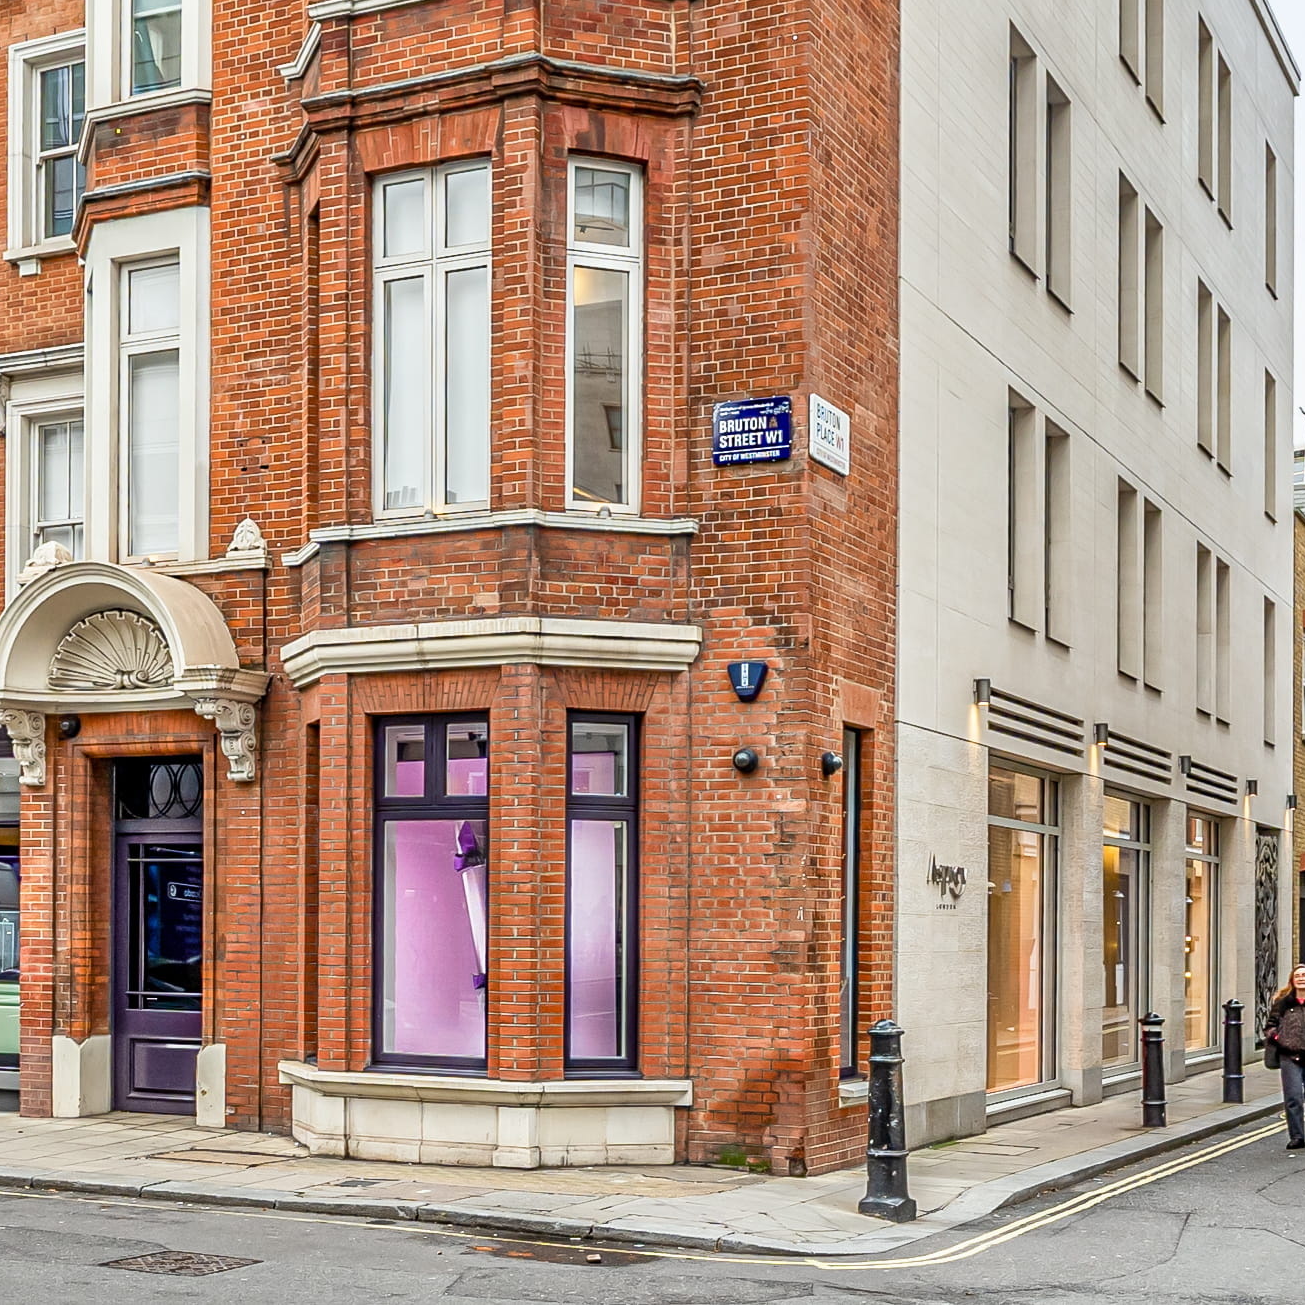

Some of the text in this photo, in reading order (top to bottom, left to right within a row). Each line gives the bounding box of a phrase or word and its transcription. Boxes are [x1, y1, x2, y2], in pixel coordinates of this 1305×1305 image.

[719, 416, 767, 434] BRUTON
[816, 402, 841, 431] BRUTON
[719, 430, 783, 448] STREET W1
[816, 422, 835, 447] PLACE
[719, 453, 732, 462] CITY
[733, 453, 740, 461] OF
